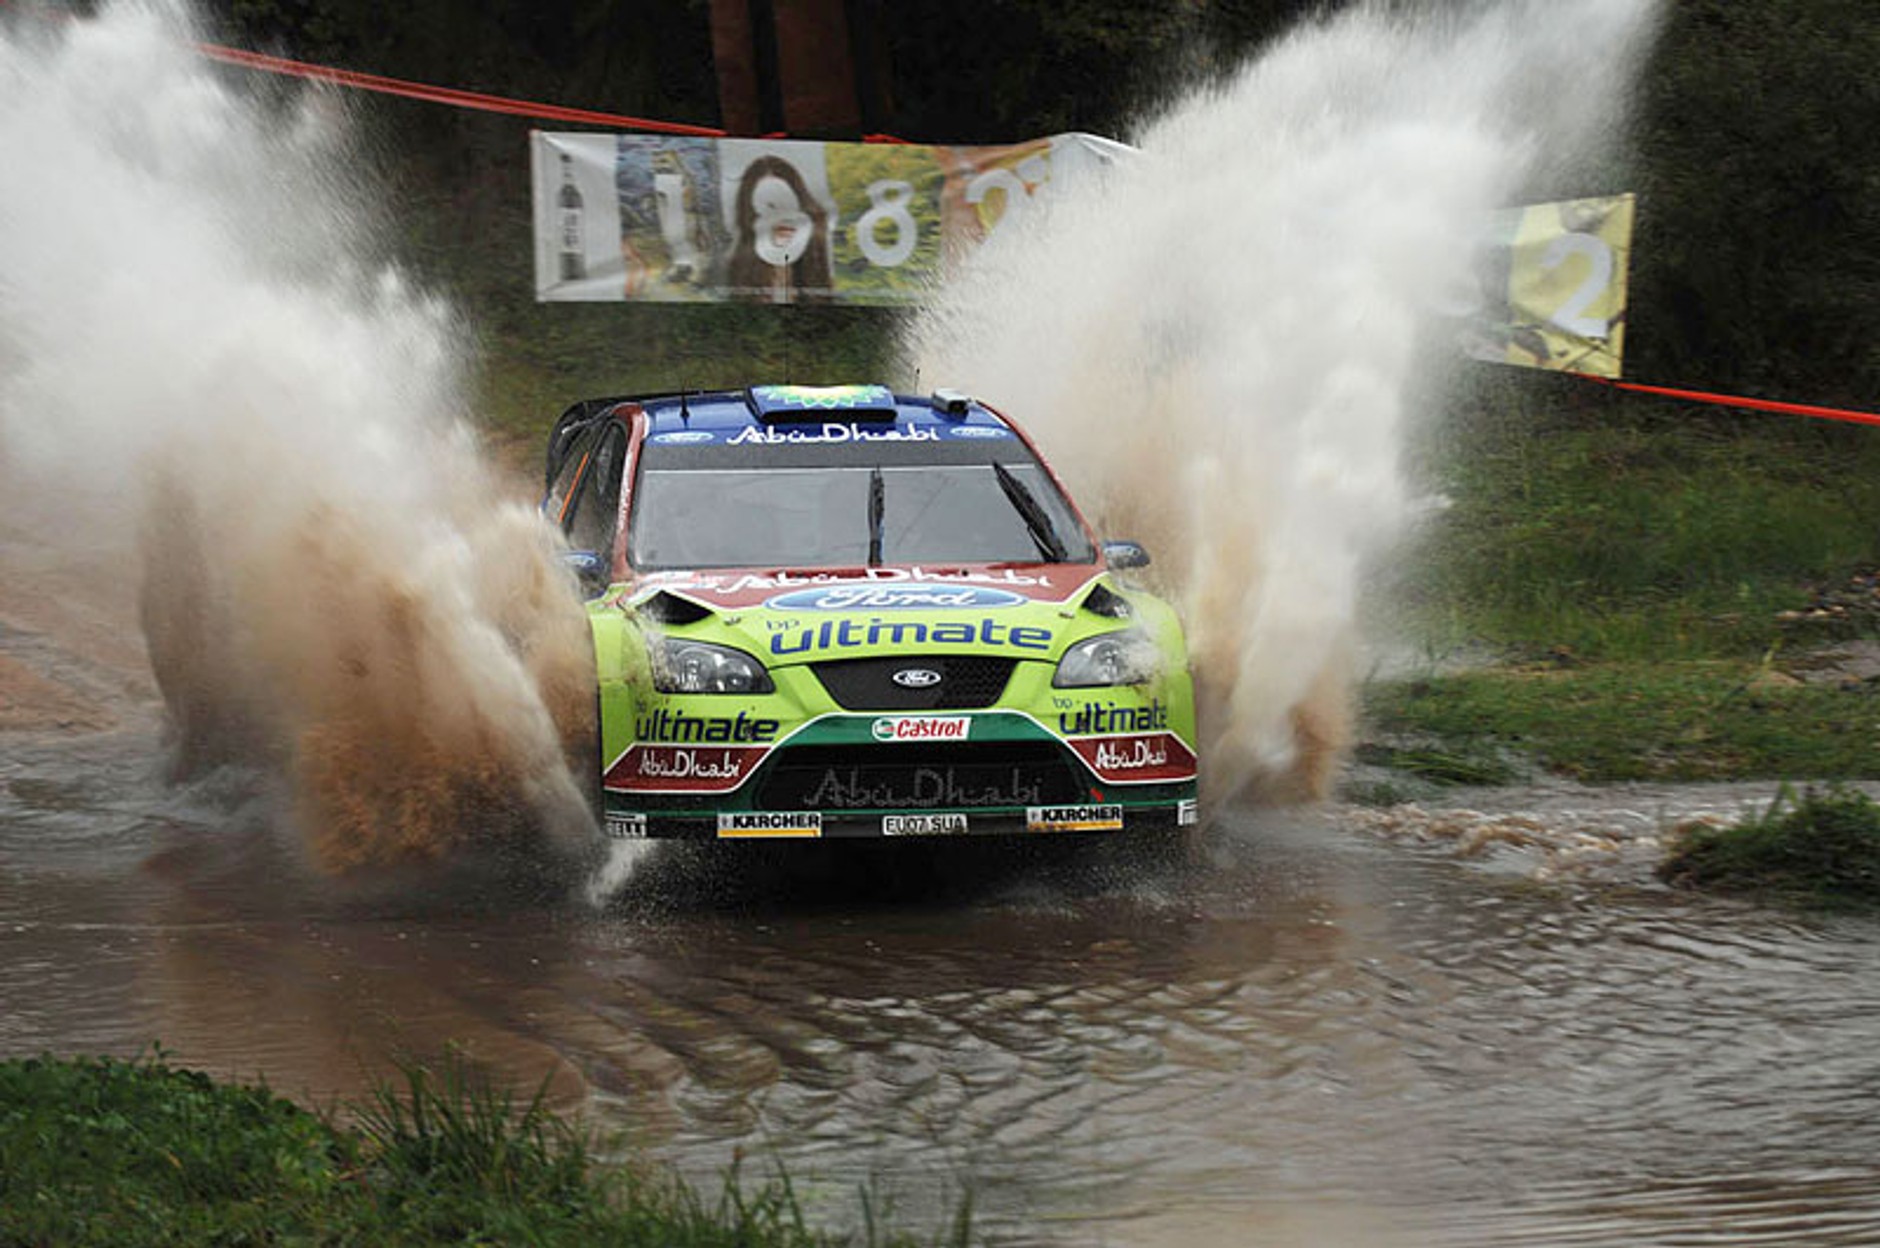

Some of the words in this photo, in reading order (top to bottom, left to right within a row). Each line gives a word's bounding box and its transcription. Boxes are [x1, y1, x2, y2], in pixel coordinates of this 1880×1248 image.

[1541, 231, 1613, 338] 2
[815, 585, 977, 608] Ford
[766, 619, 800, 632] bp
[771, 617, 1052, 654] ultimate
[636, 709, 779, 742] ultimate
[896, 719, 964, 740] Castrol
[886, 817, 927, 834] EU07
[931, 815, 963, 833] SUA
